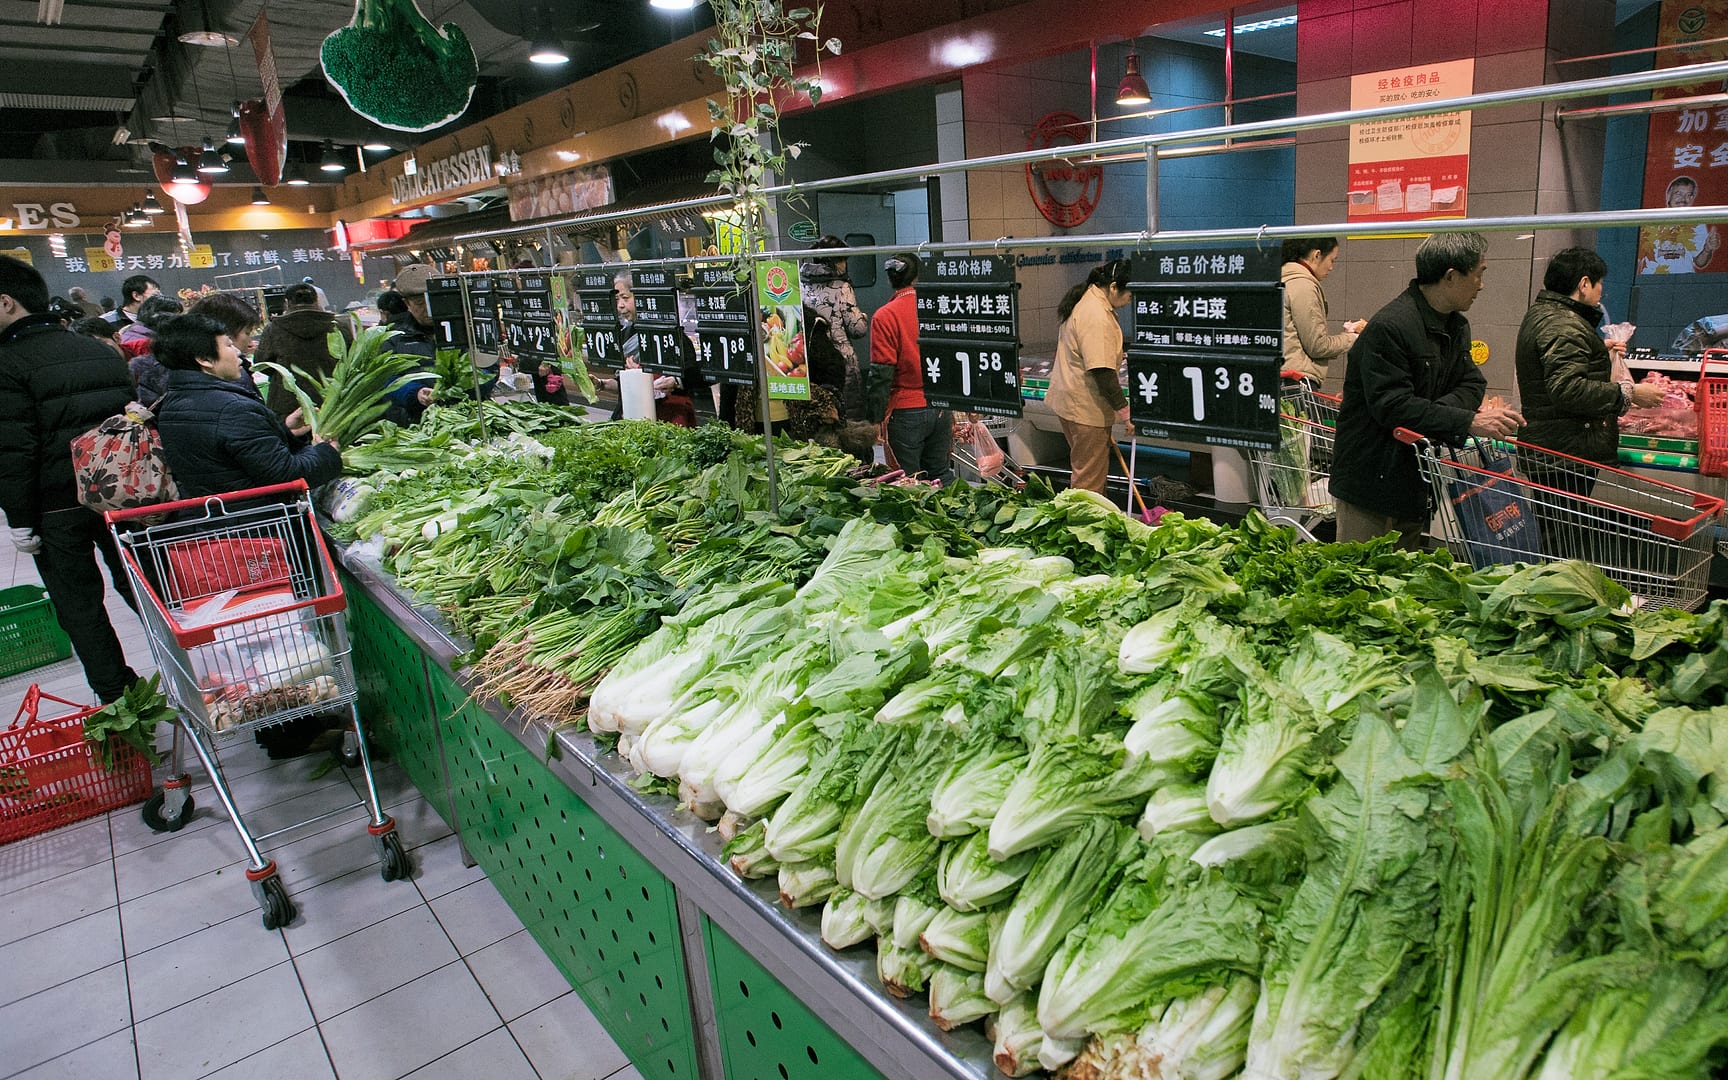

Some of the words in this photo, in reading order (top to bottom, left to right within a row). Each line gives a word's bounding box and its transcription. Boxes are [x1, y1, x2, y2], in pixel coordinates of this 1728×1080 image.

[1377, 71, 1440, 90] 经检疫肉品
[1379, 93, 1408, 103] 买的放心
[1410, 88, 1440, 99] 吃的安心
[391, 145, 492, 203] DELICATESSEN
[937, 259, 993, 276] 商品价格牌
[1159, 254, 1245, 275] 商品价格牌
[640, 273, 665, 284] 商品价格牌
[703, 269, 735, 282] 商品价格牌
[917, 298, 936, 310] 品名:
[937, 294, 1010, 315] 意大利生菜
[1136, 301, 1163, 315] 品名:
[1173, 296, 1227, 320] 水白菜
[586, 333, 594, 349] ¥
[595, 331, 614, 359] 0.98
[640, 333, 648, 352] ¥
[653, 333, 675, 365] 1.58
[1254, 335, 1278, 346] 500g
[702, 341, 712, 362] ¥
[719, 336, 745, 370] 1.88
[925, 357, 941, 383] ¥
[955, 351, 1002, 396] 1.58
[769, 381, 807, 394] 基地直供
[1137, 371, 1159, 404] ¥
